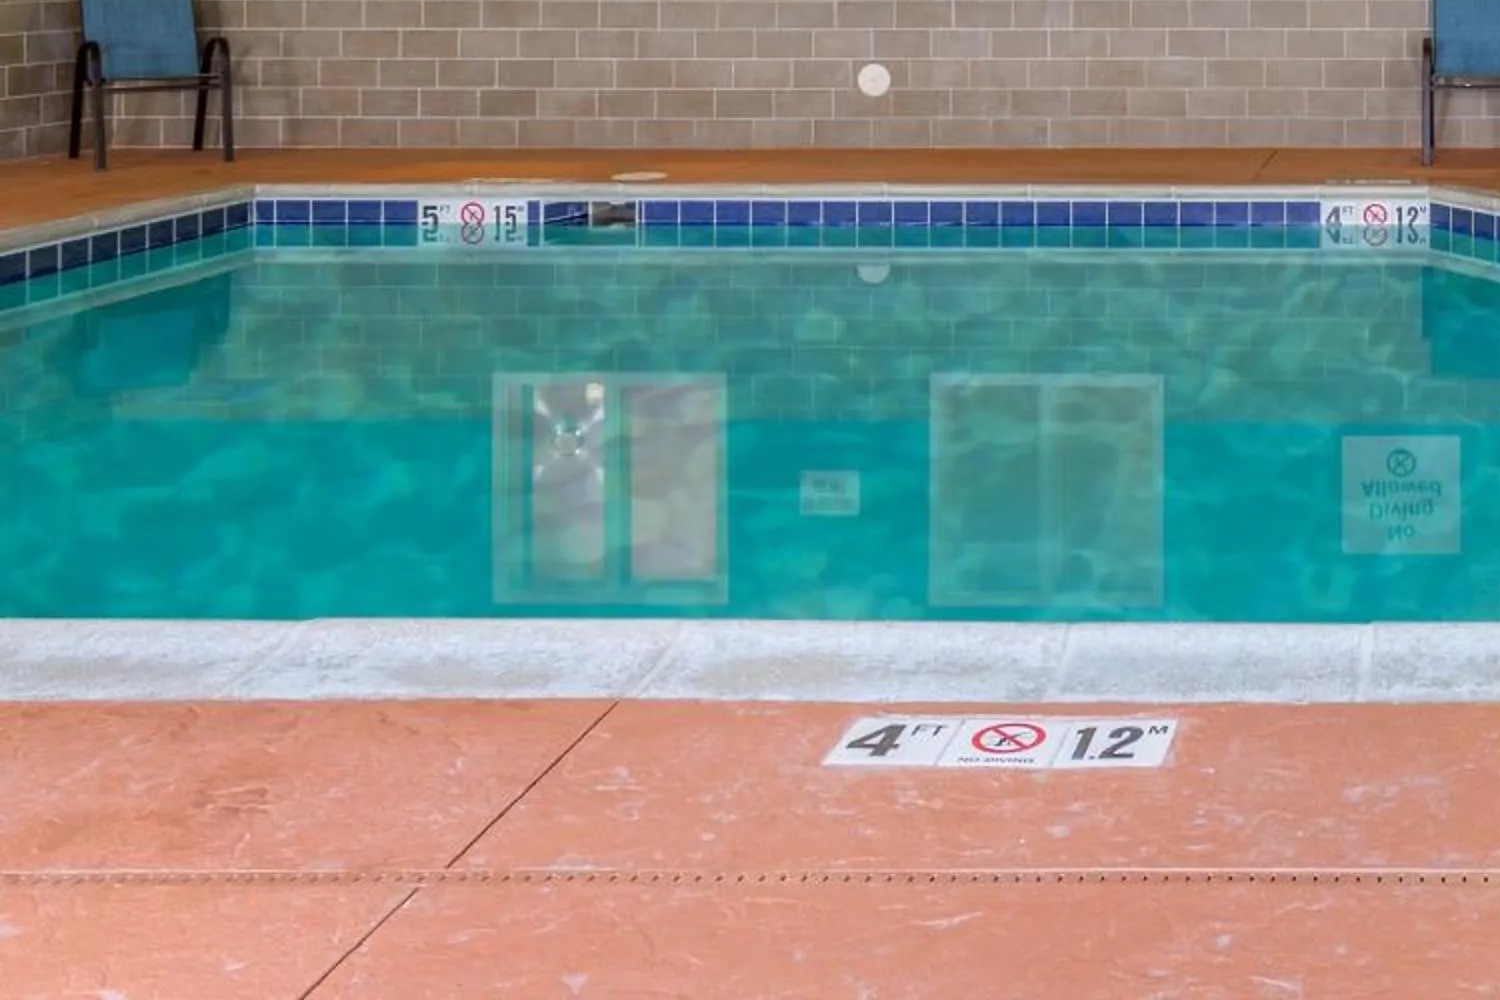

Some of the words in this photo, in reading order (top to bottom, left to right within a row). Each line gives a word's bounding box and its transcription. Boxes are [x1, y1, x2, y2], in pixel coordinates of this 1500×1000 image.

[846, 724, 907, 757] 4
[911, 724, 949, 736] FT
[1071, 725, 1146, 760] 1.2
[1147, 725, 1169, 735] M
